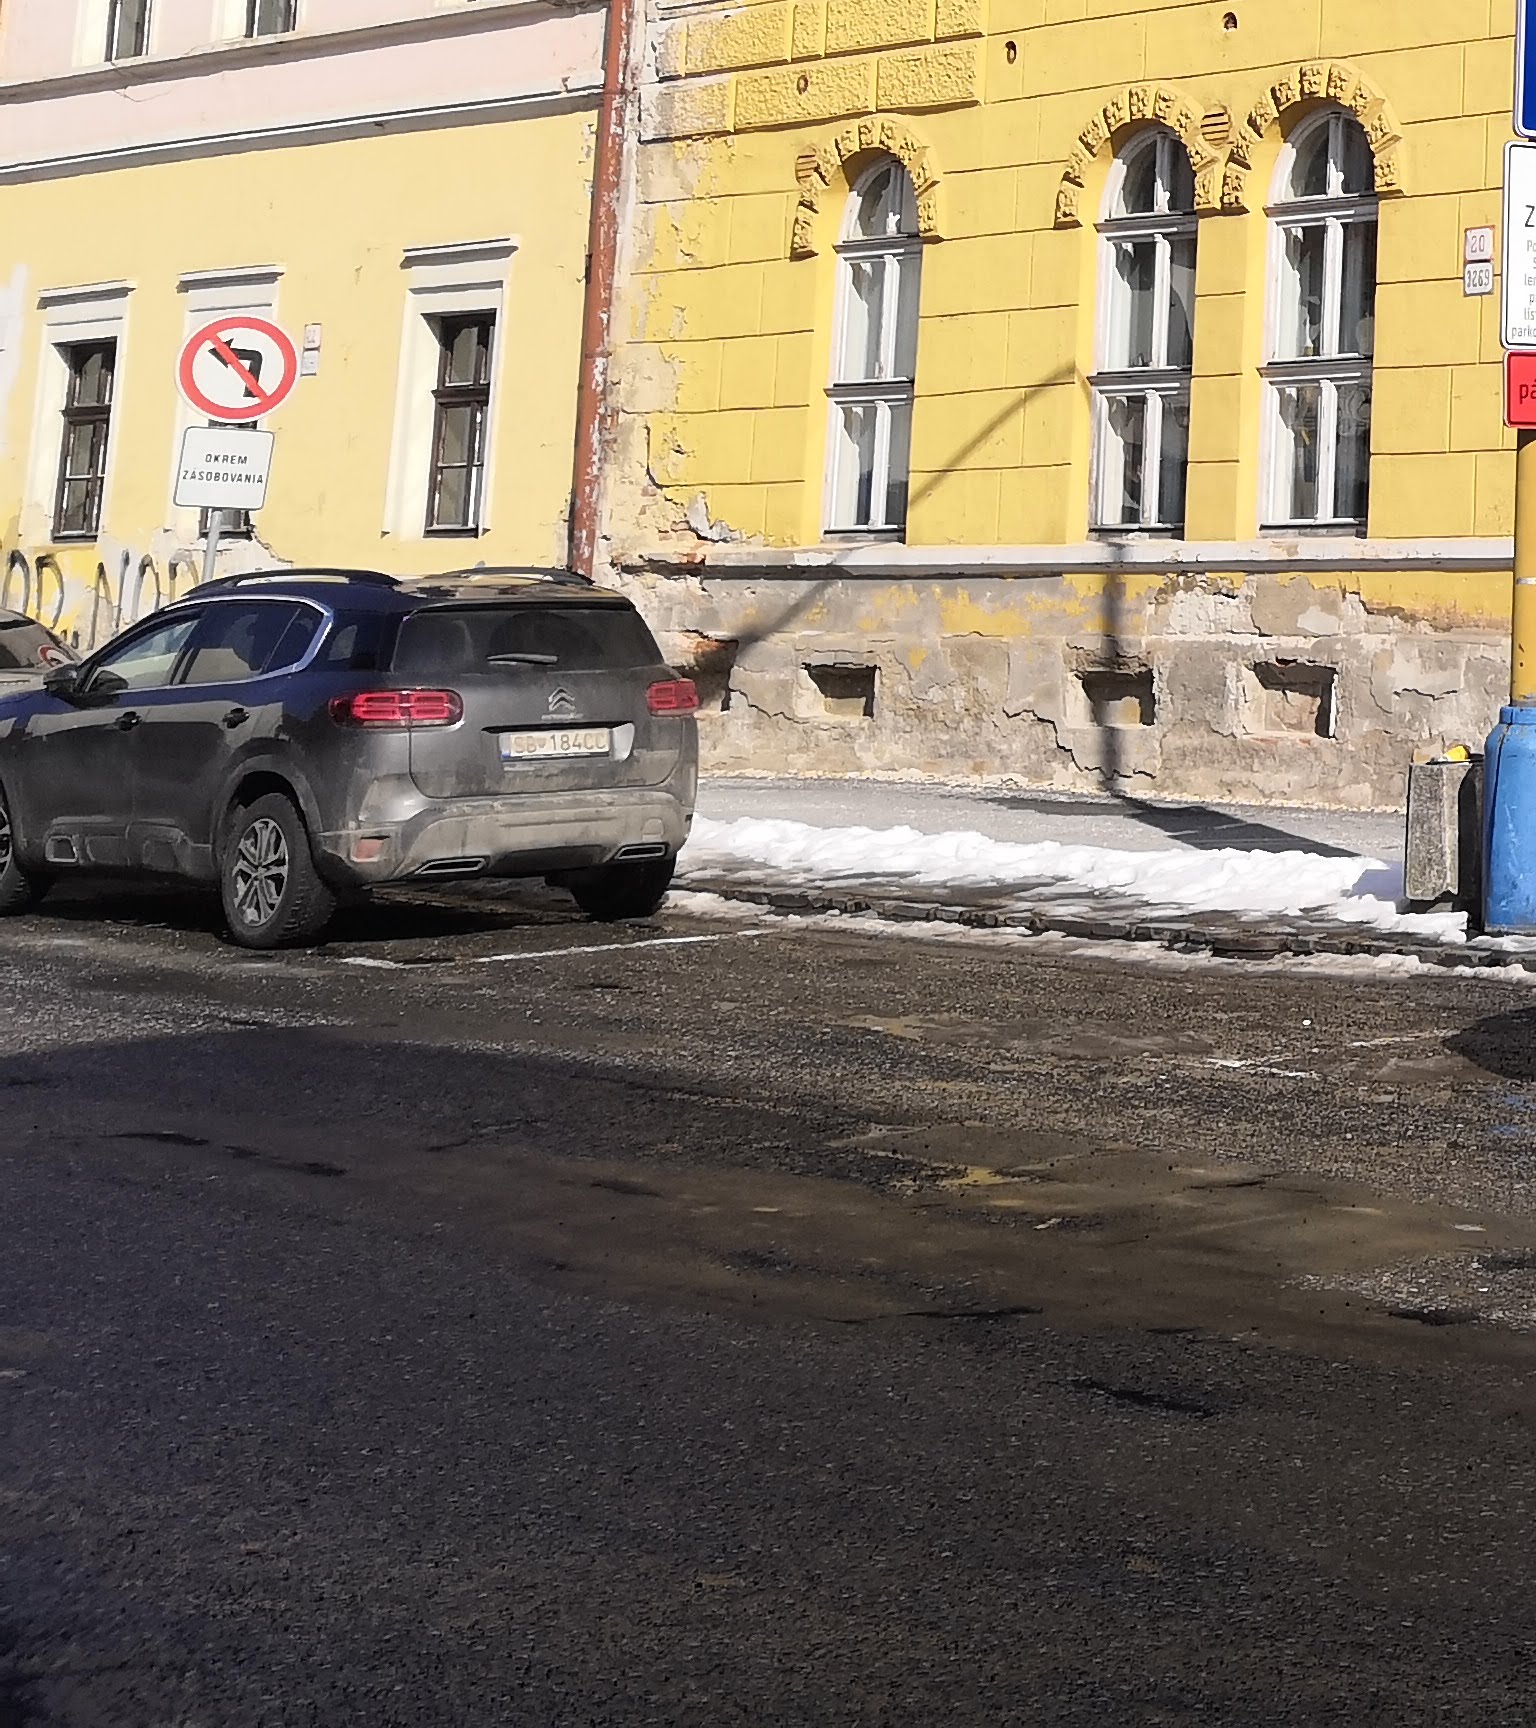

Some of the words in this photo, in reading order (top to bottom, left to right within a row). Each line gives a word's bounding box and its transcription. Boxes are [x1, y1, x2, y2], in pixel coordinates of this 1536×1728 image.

[1470, 235, 1485, 253] 20
[1466, 268, 1490, 288] 3269
[205, 453, 248, 465] OKREM
[182, 467, 264, 484] ZÁSOBOVANIA
